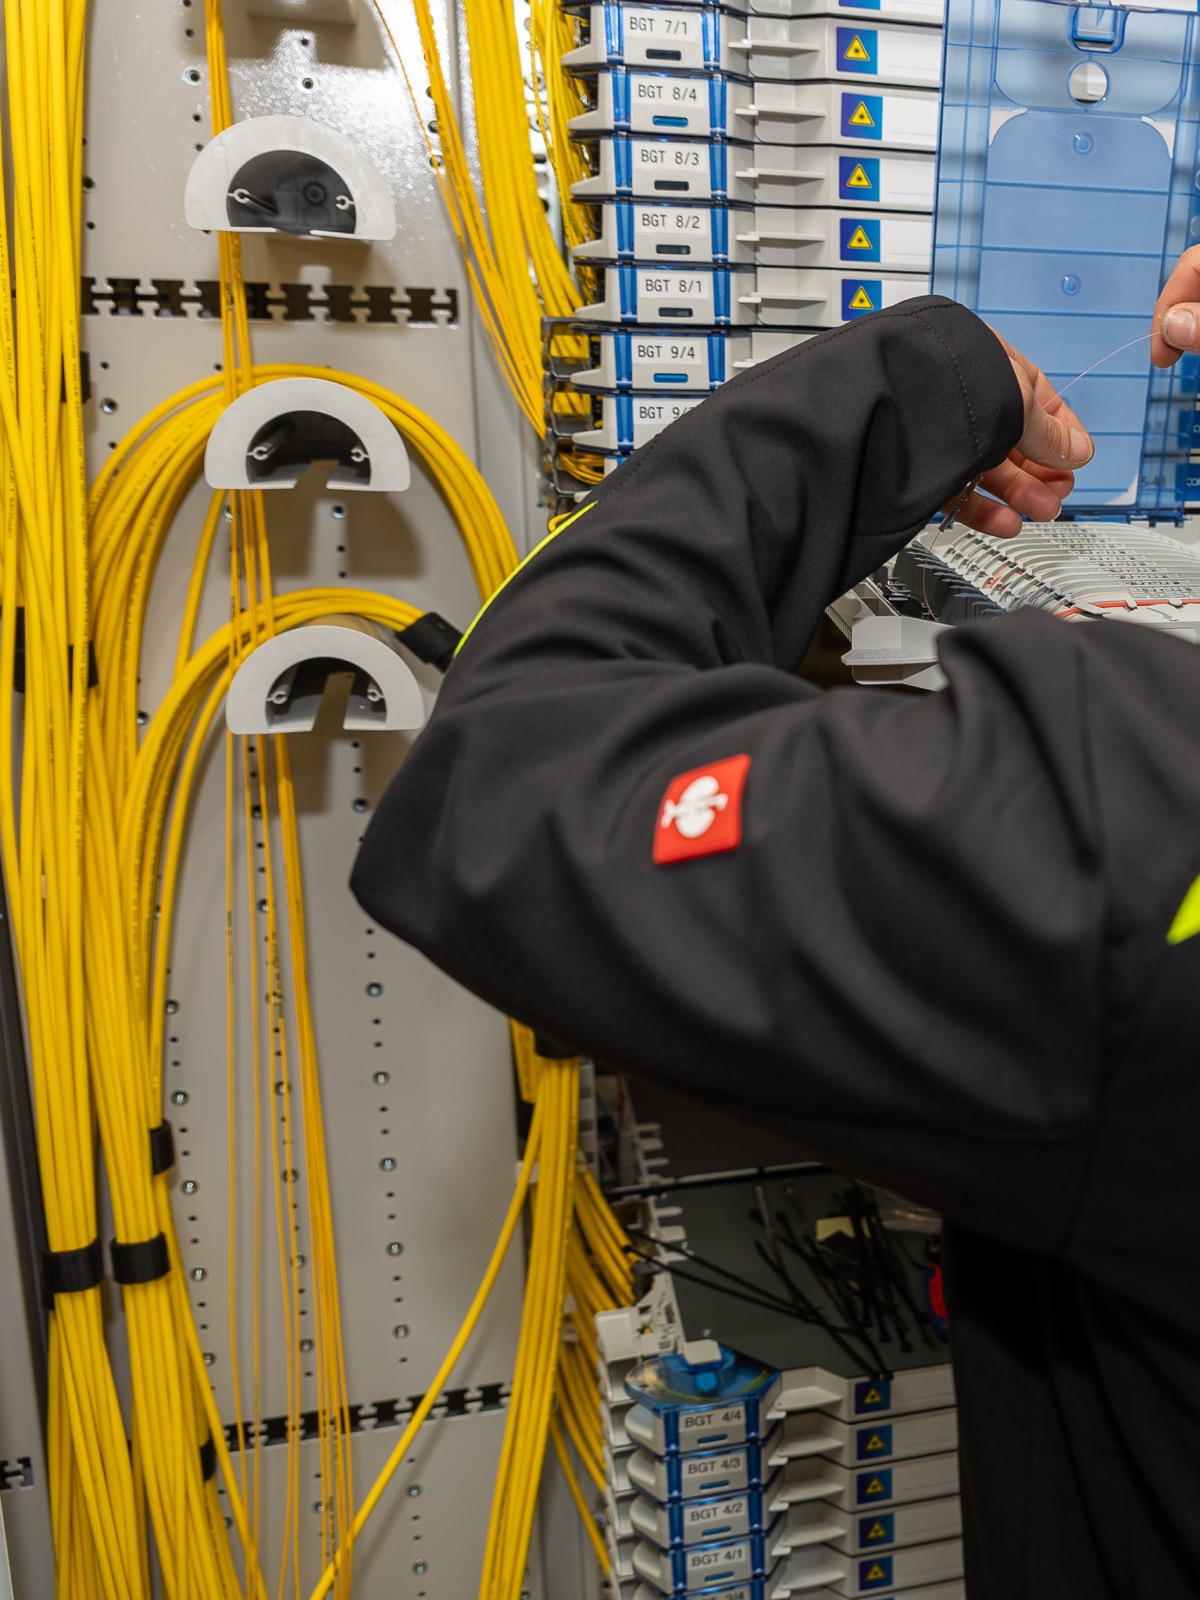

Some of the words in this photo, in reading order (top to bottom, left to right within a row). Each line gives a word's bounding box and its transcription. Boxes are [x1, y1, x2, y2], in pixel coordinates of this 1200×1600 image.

[629, 16, 656, 33] BGT
[664, 19, 688, 35] 7/1
[638, 84, 664, 100] BGT
[671, 86, 697, 102] 8/4
[640, 149, 666, 164] BGT
[674, 151, 700, 167] 8/3
[642, 213, 667, 228] BGT
[675, 215, 701, 230] 8/2
[645, 278, 671, 293] BGT
[678, 279, 703, 295] 8/1
[638, 344, 664, 359] BGT
[670, 344, 696, 360] 9/4
[639, 406, 664, 419] BGT
[672, 406, 695, 420] 9/
[684, 1413, 714, 1428] BGT
[721, 1410, 742, 1423] 4/4
[688, 1460, 717, 1475] BGT
[720, 1456, 741, 1470] 4/3
[690, 1506, 719, 1522] BGT
[723, 1502, 743, 1515] 4/2
[691, 1552, 720, 1567] BGT
[723, 1548, 743, 1562] 4/1
